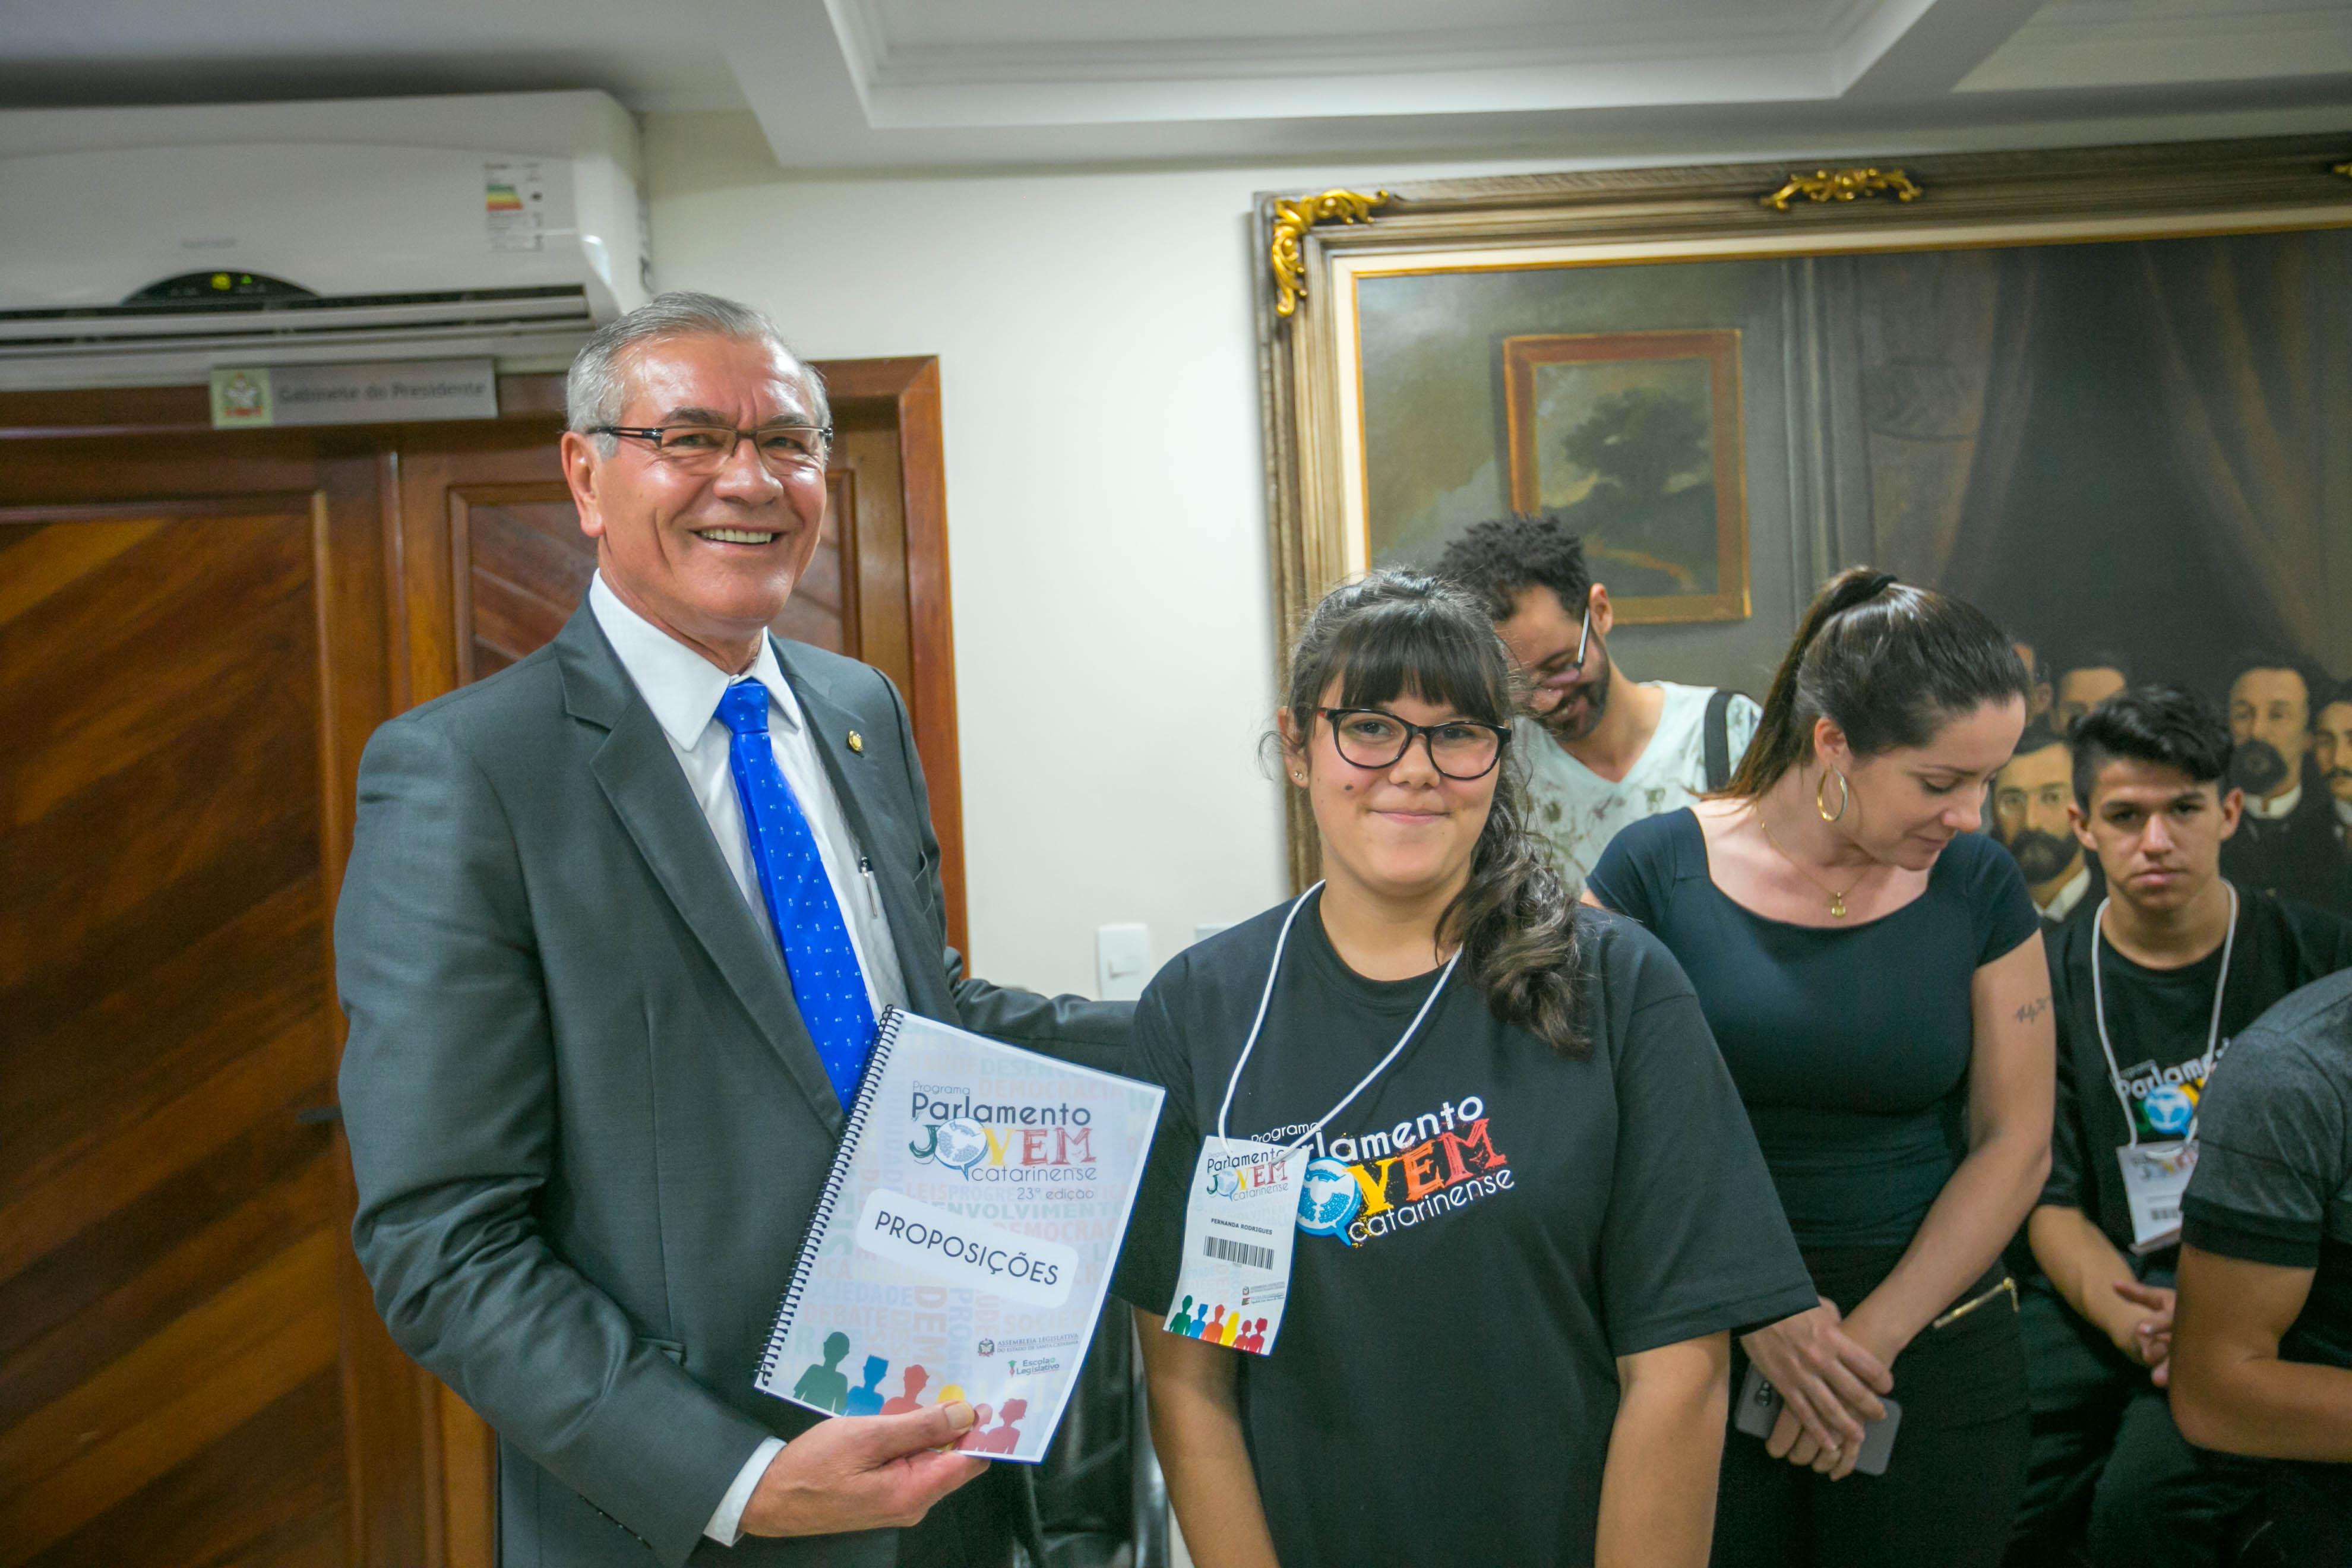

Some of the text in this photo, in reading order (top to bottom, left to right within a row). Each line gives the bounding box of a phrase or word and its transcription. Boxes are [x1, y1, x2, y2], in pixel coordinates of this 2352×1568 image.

[913, 1080, 970, 1096] Programa
[911, 1092, 1091, 1126] Parlamento
[909, 1119, 1097, 1169] JOVEM
[971, 1165, 1098, 1182] catarinense
[1206, 1161, 1288, 1196] JOVEM
[1297, 1118, 1508, 1232] OVEM
[1045, 1187, 1095, 1201] edição
[1232, 1183, 1289, 1202] catarinense
[1348, 1169, 1515, 1243] catarinense
[1210, 1218, 1273, 1235] FERNANDA RODRIGUES
[874, 1210, 1059, 1285] PROPOSIÇÕES
[1039, 1333, 1078, 1342] LEGISLATIVA
[1016, 1363, 1060, 1375] Legislativo
[1022, 1358, 1050, 1367] Escola
